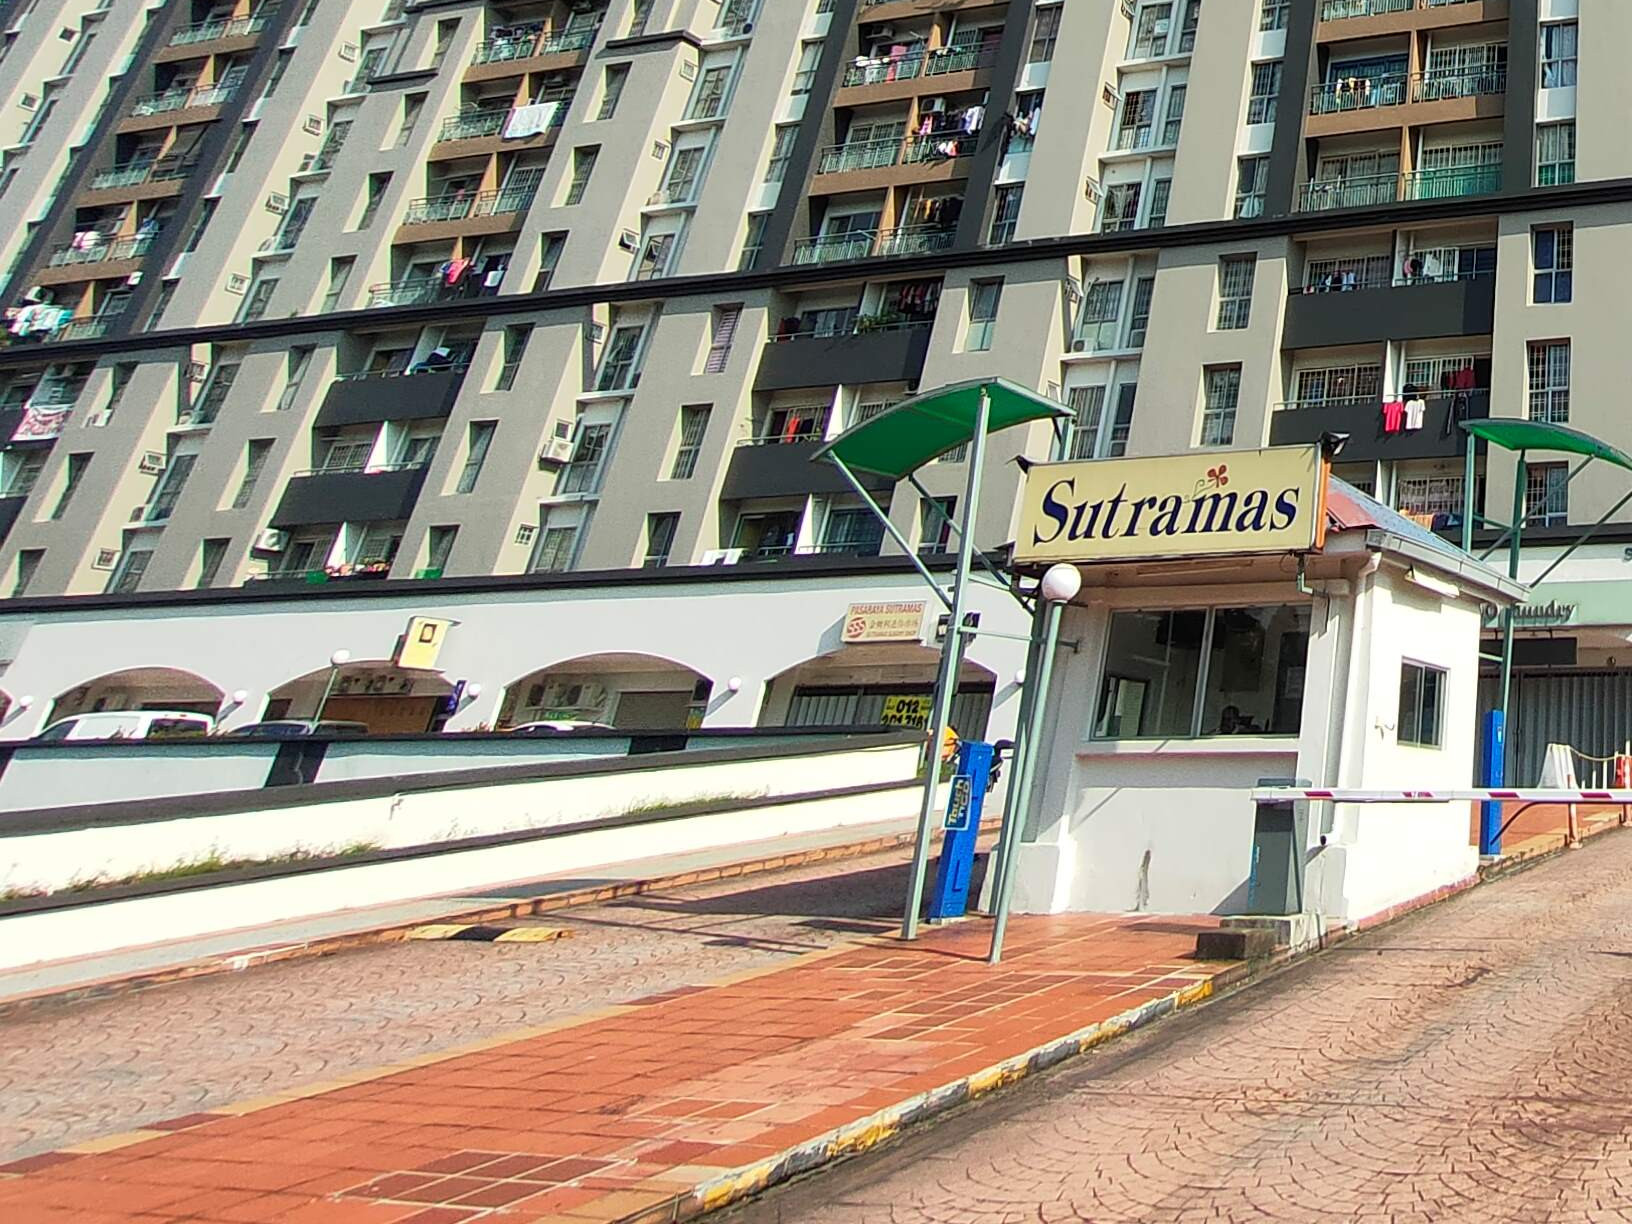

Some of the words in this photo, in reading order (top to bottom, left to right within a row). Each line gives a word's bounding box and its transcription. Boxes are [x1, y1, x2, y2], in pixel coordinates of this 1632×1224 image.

[1033, 477, 1300, 547] Sutramas
[851, 604, 884, 615] PASARAYA
[886, 603, 922, 614] SUTRAMAS
[1508, 600, 1576, 622] aundry
[896, 699, 919, 714] 012
[947, 779, 964, 825] Touch
